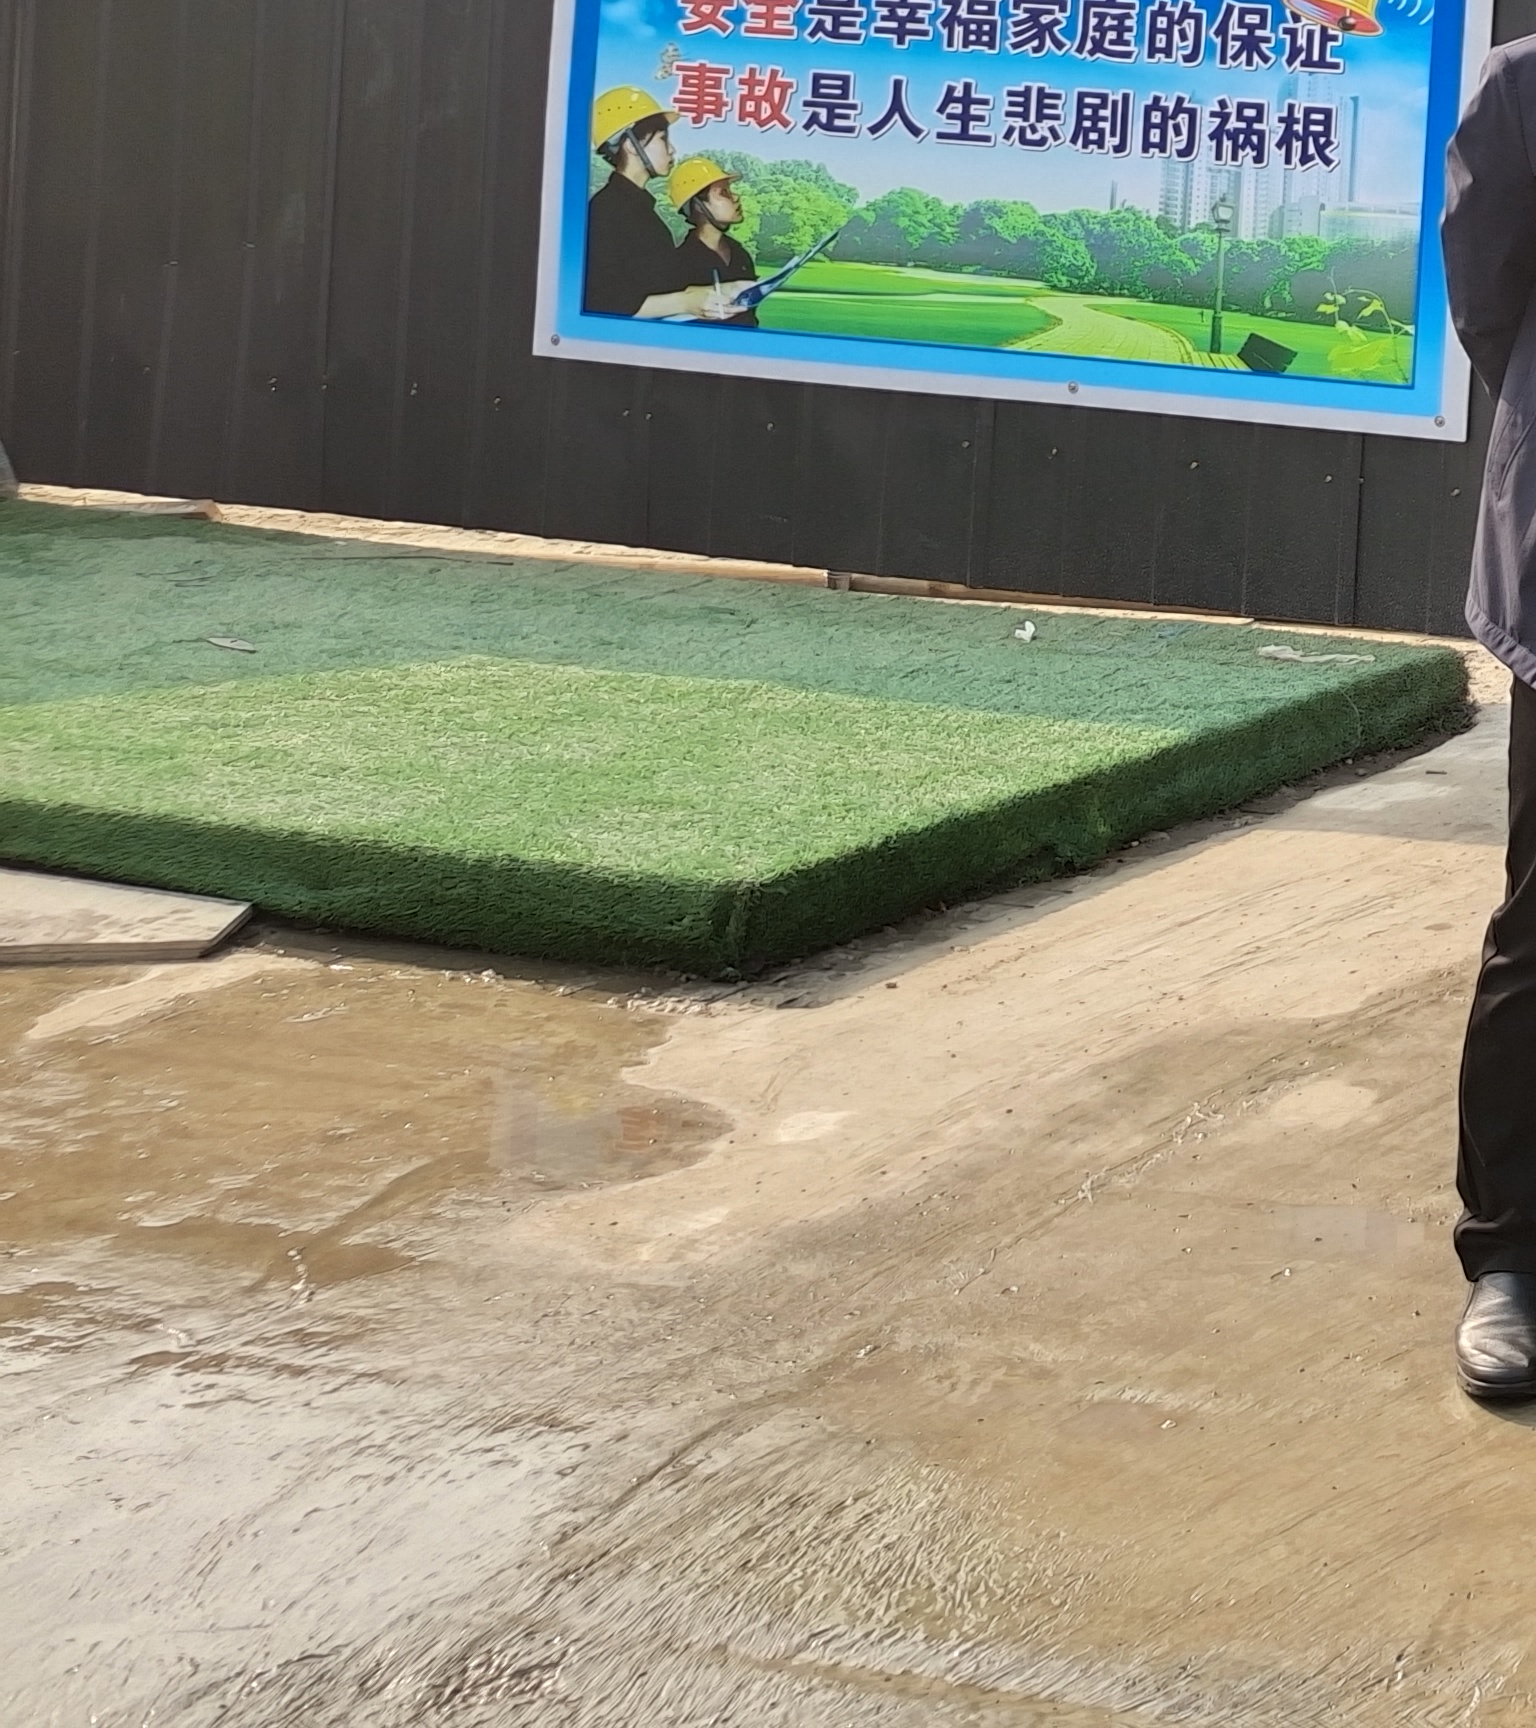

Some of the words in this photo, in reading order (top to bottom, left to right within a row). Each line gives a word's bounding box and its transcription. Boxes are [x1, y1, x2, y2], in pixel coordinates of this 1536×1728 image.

[671, 60, 1339, 171] 事故是人生悲剧的祸根
